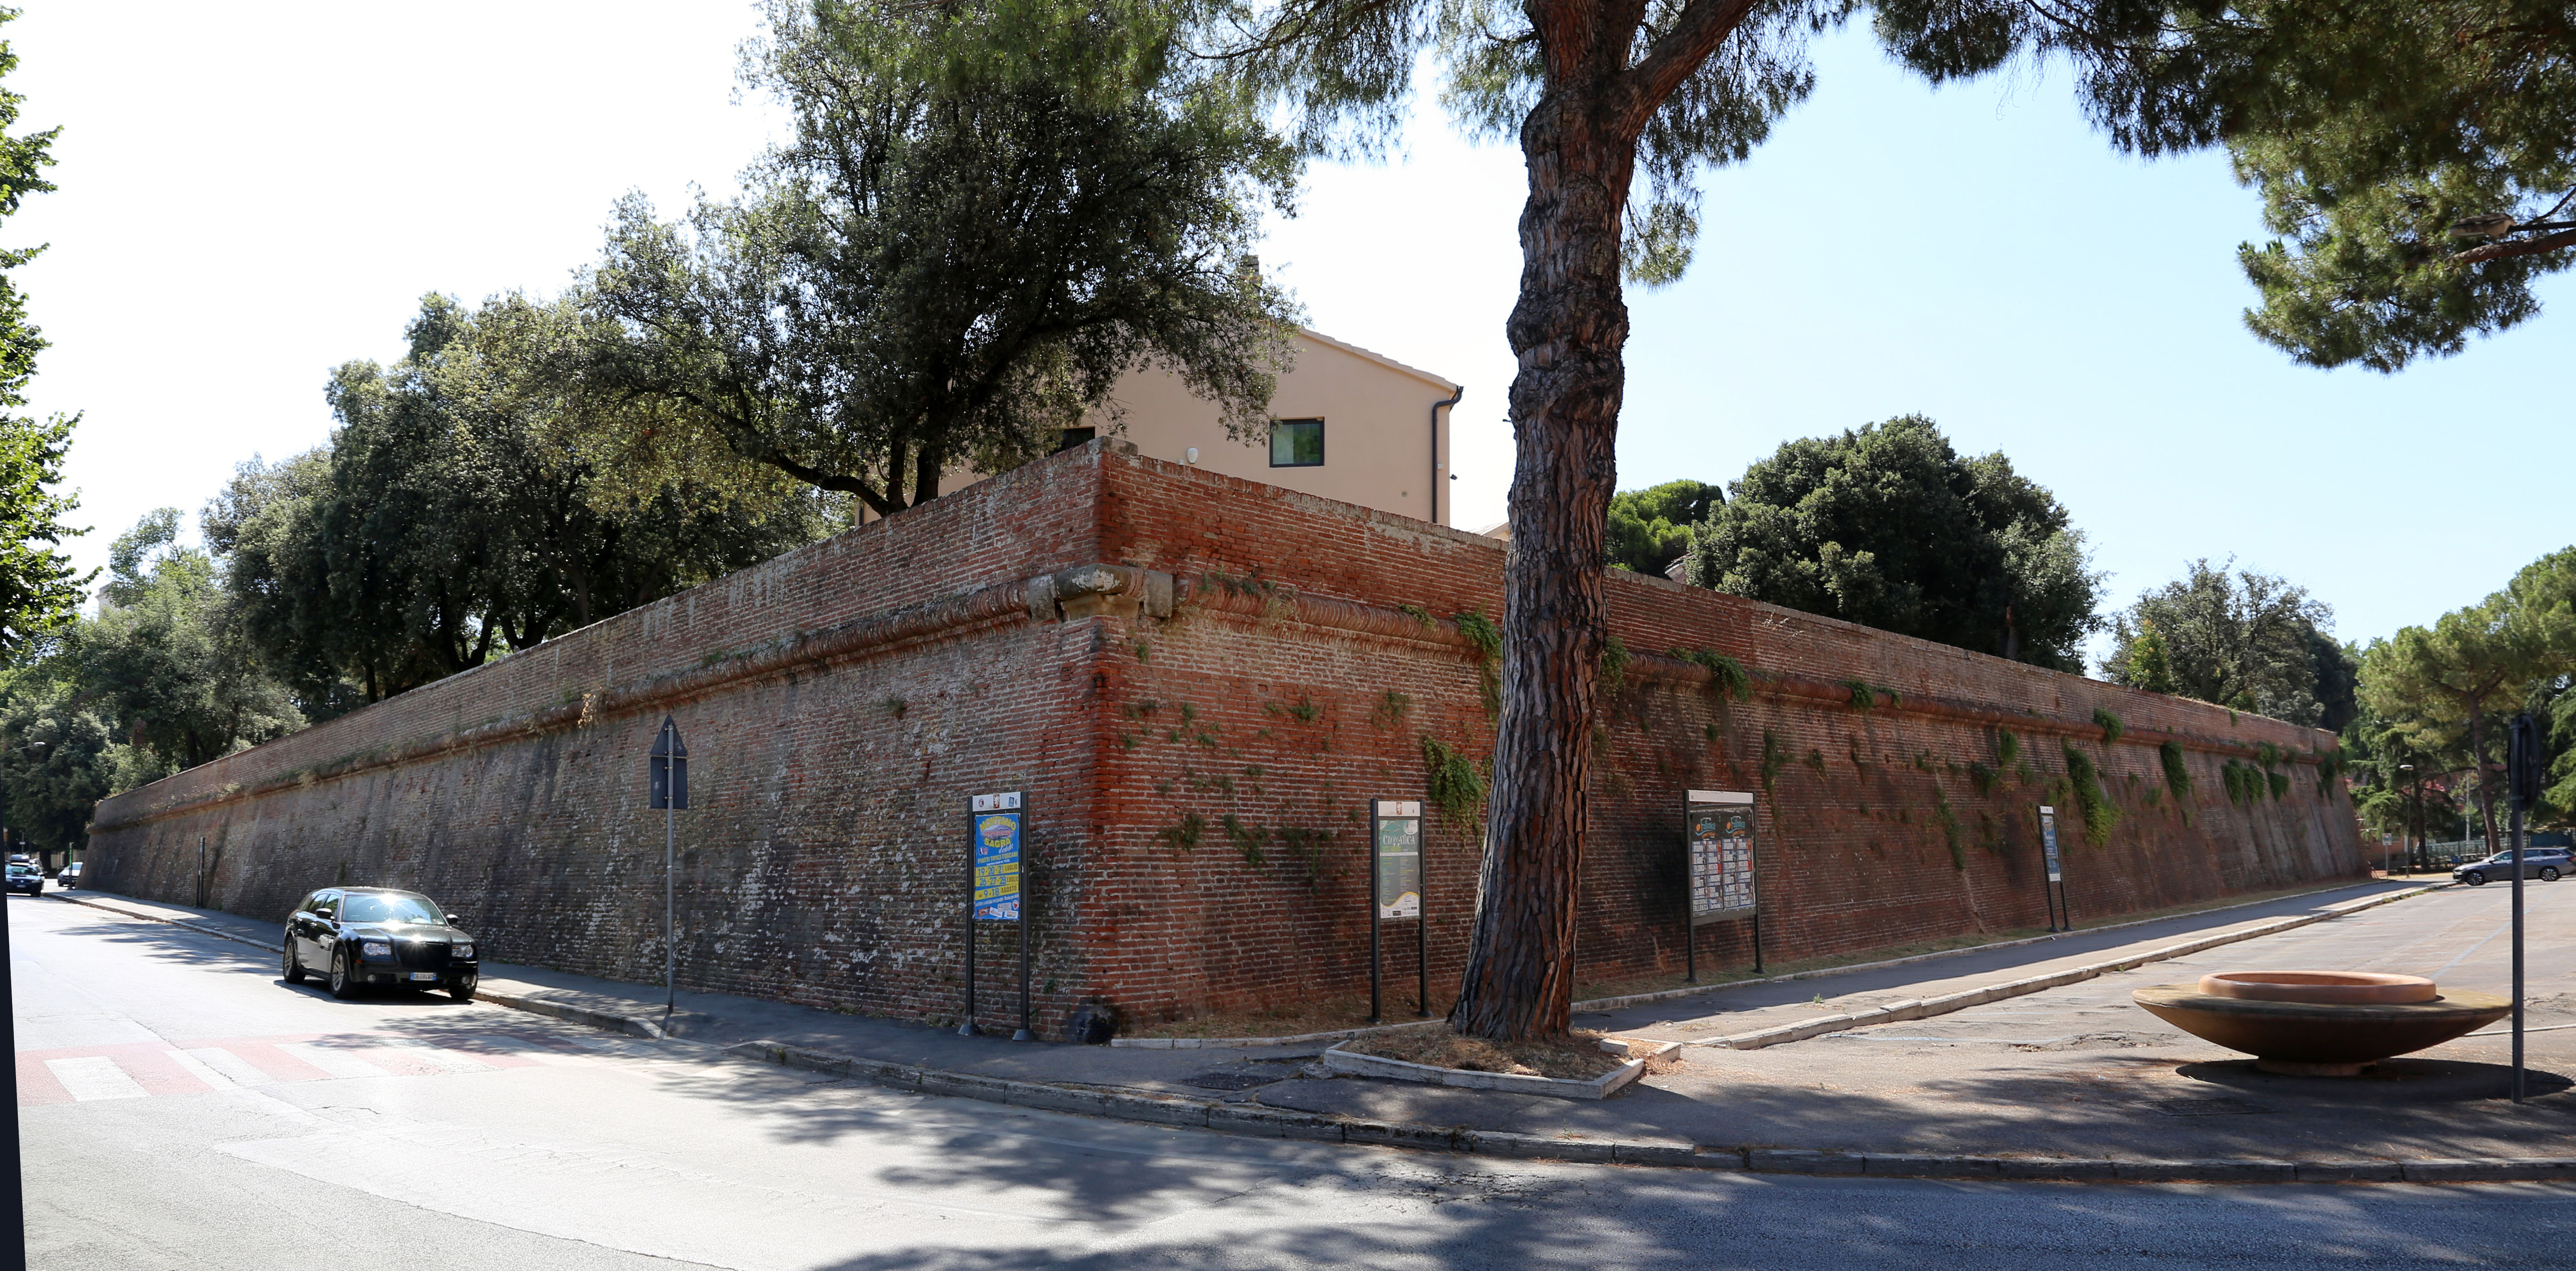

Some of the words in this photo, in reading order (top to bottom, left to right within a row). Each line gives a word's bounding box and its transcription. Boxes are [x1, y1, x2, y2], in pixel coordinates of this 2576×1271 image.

[979, 816, 1016, 832] MONTIANO
[984, 838, 1011, 848] SAGRA
[978, 868, 984, 876] 19
[988, 867, 994, 875] 20
[979, 877, 987, 886] 26
[990, 876, 996, 885] 27
[1000, 876, 1006, 884] 28
[984, 890, 988, 898] 9
[992, 888, 1000, 897] 18
[1001, 885, 1017, 893] AGOSTO
